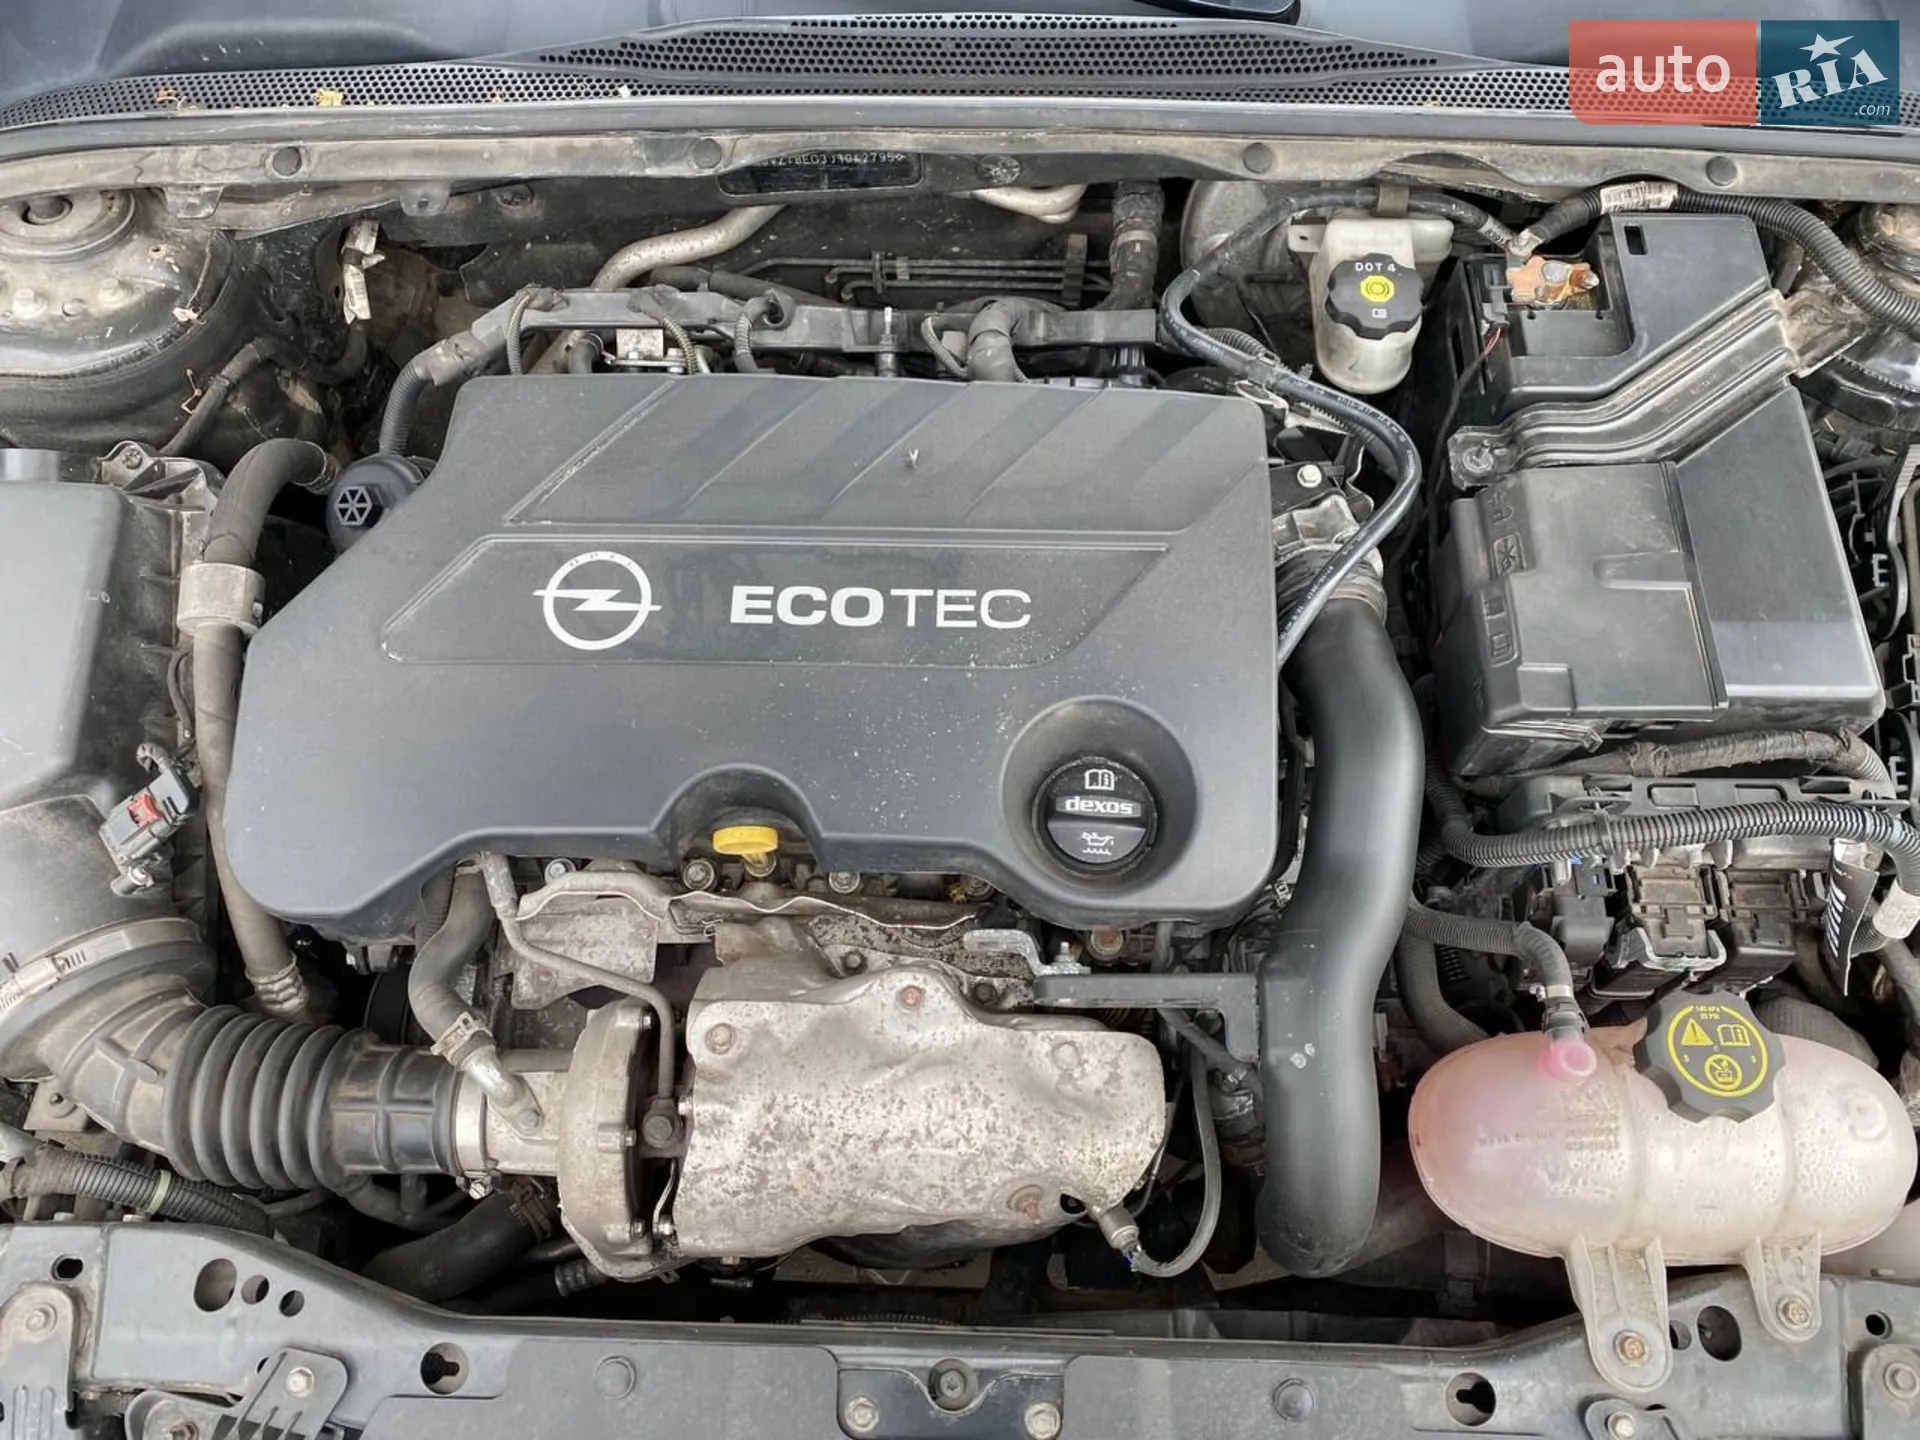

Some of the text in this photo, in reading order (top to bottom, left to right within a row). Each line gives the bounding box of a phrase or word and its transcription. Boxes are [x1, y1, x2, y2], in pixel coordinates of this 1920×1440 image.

[1355, 262, 1396, 272] DOT 4
[730, 585, 1032, 629] ECOTEC
[1065, 796, 1134, 815] dexos
